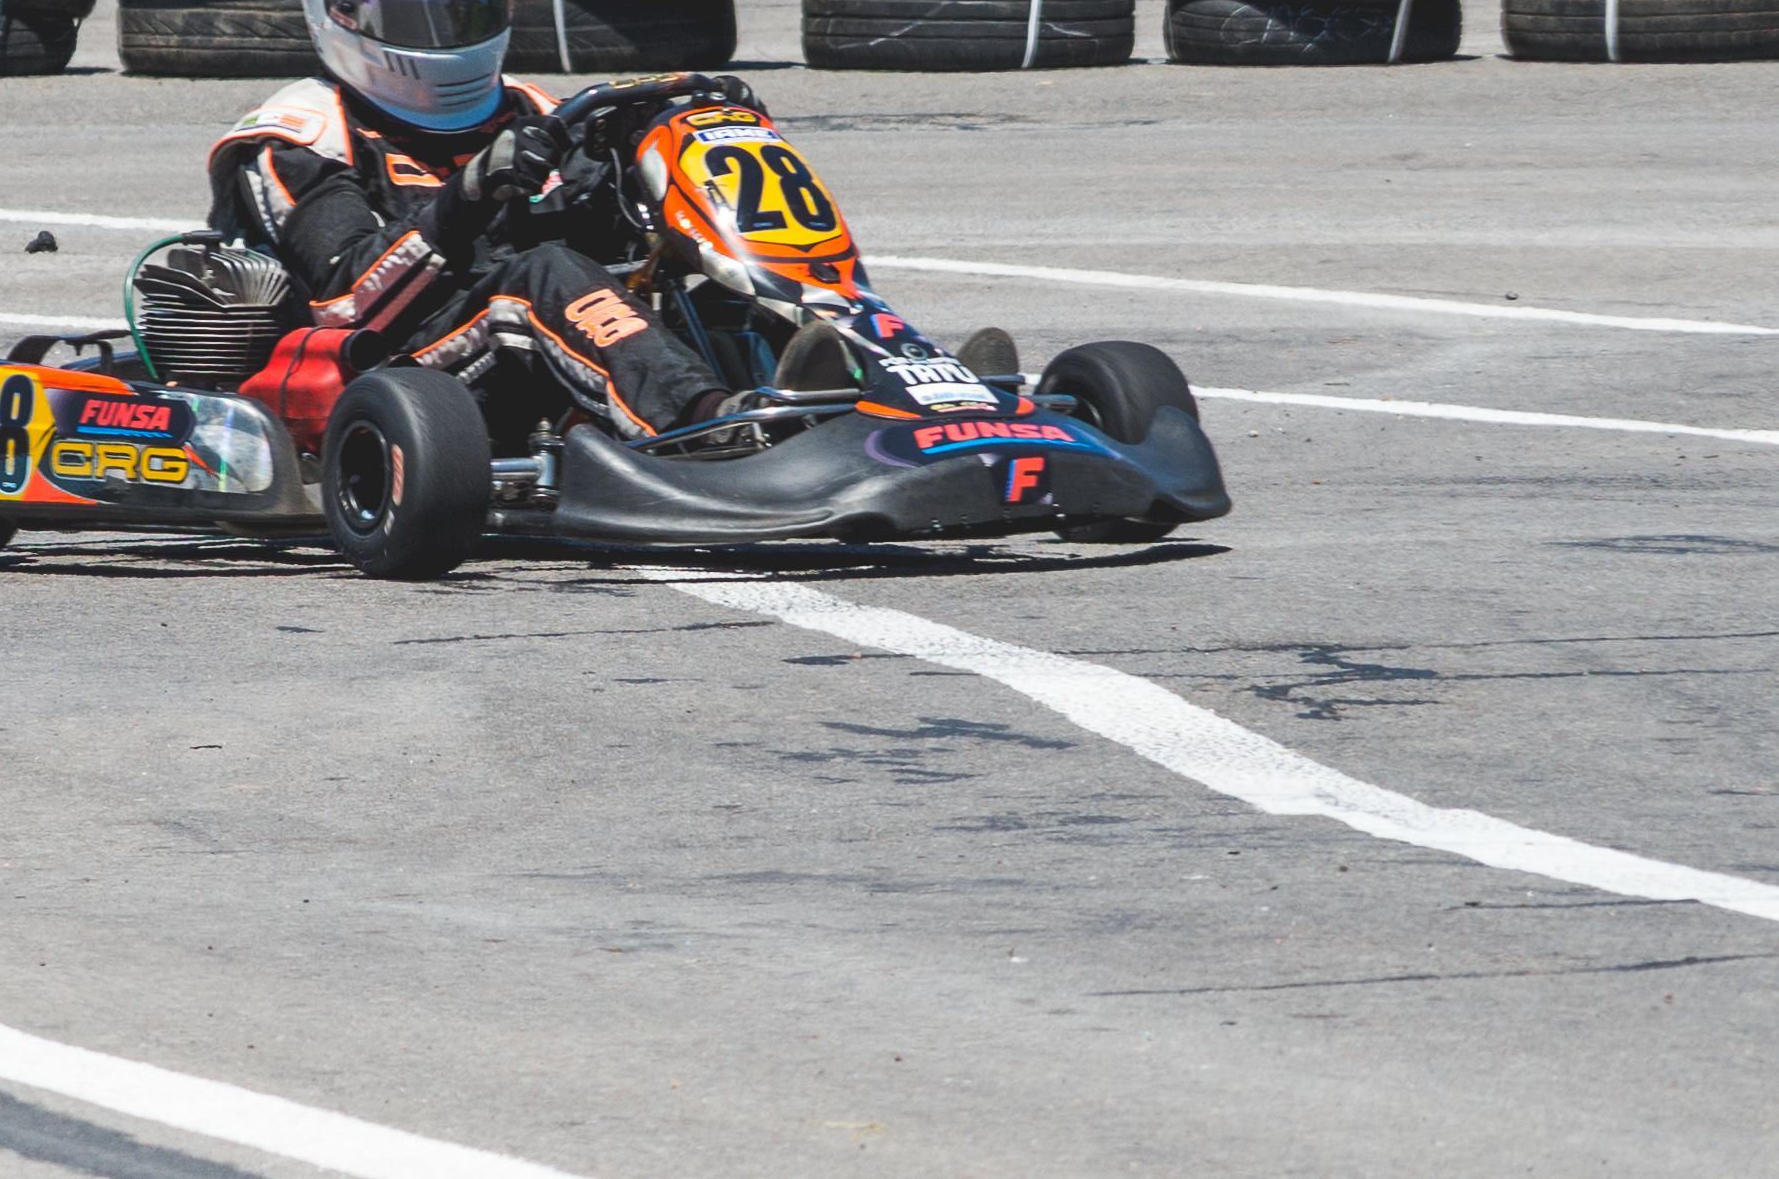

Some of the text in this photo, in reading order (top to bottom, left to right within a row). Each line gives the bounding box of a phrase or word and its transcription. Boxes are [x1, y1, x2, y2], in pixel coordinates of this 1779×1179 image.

[705, 144, 837, 233] 28
[886, 363, 980, 385] TATU
[79, 399, 172, 431] FUNSA
[913, 422, 1076, 449] FUNSA
[51, 441, 189, 484] CRG
[1005, 457, 1045, 502] F
